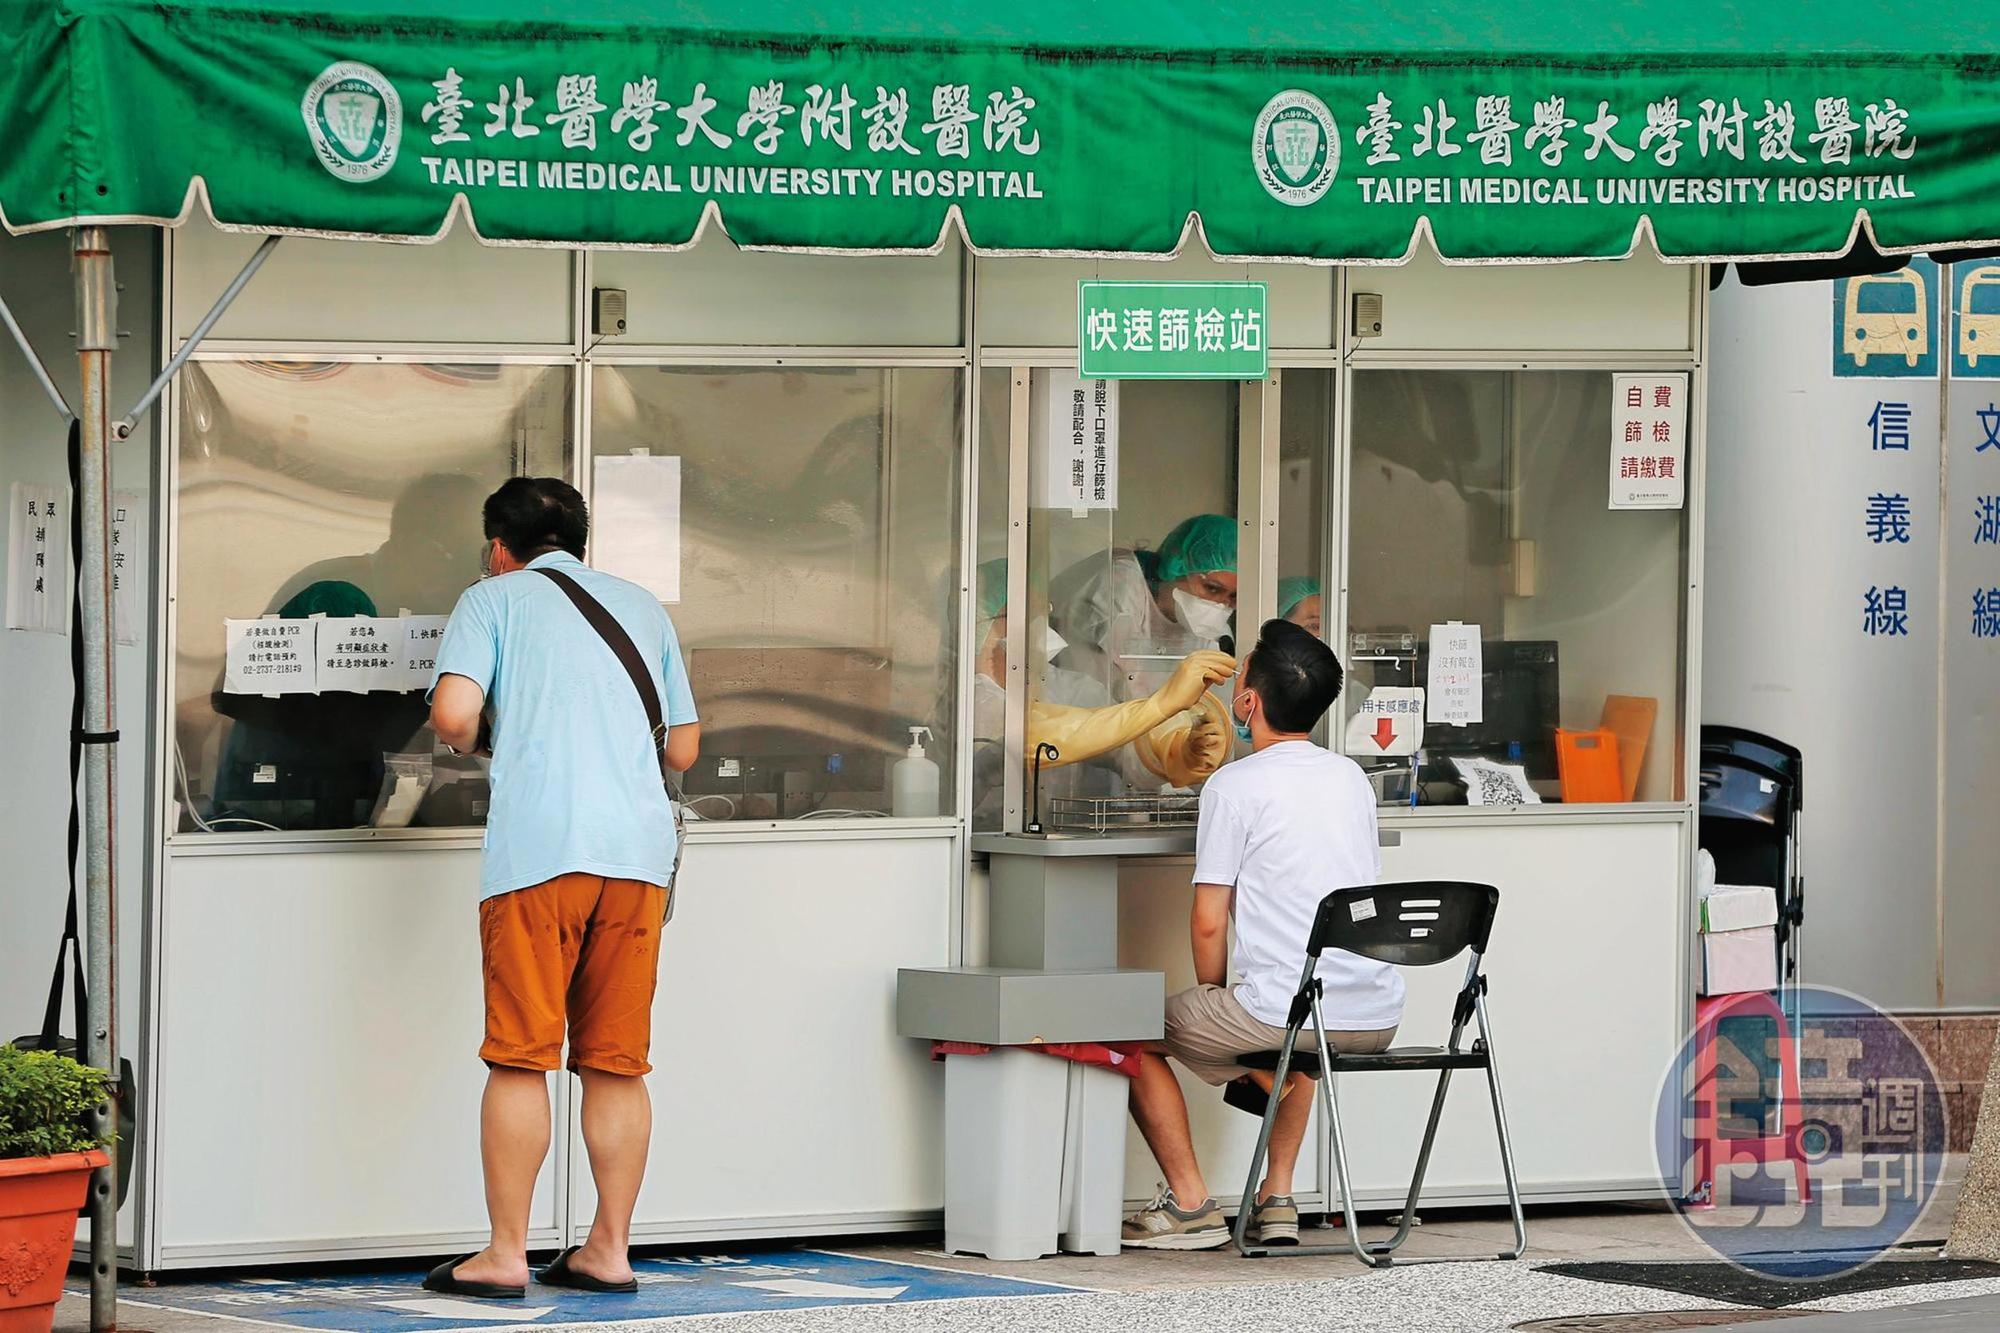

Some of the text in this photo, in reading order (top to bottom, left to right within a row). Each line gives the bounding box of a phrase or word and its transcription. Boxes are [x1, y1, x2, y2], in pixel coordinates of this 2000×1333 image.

[421, 67, 1040, 159] 臺北醫學大學附設醫院
[1355, 91, 1917, 167] 臺北醫學大學附設醫院
[347, 164, 368, 174] 1976
[421, 156, 1043, 198] TAIPEI MEDICAL UNIVERSITY HOSPITAL
[1288, 189, 1307, 199] 1976
[1357, 174, 1916, 204] TAIPEI MEDICAL UNIVERSITY HOSPITAL
[1086, 307, 1261, 352] 快速篩檢站
[1627, 385, 1671, 408] 自費
[1625, 420, 1670, 443] 篩檢
[1620, 456, 1675, 479] 請繳費
[1863, 400, 1912, 637] 信義線
[1357, 699, 1420, 713] 用卡感應處
